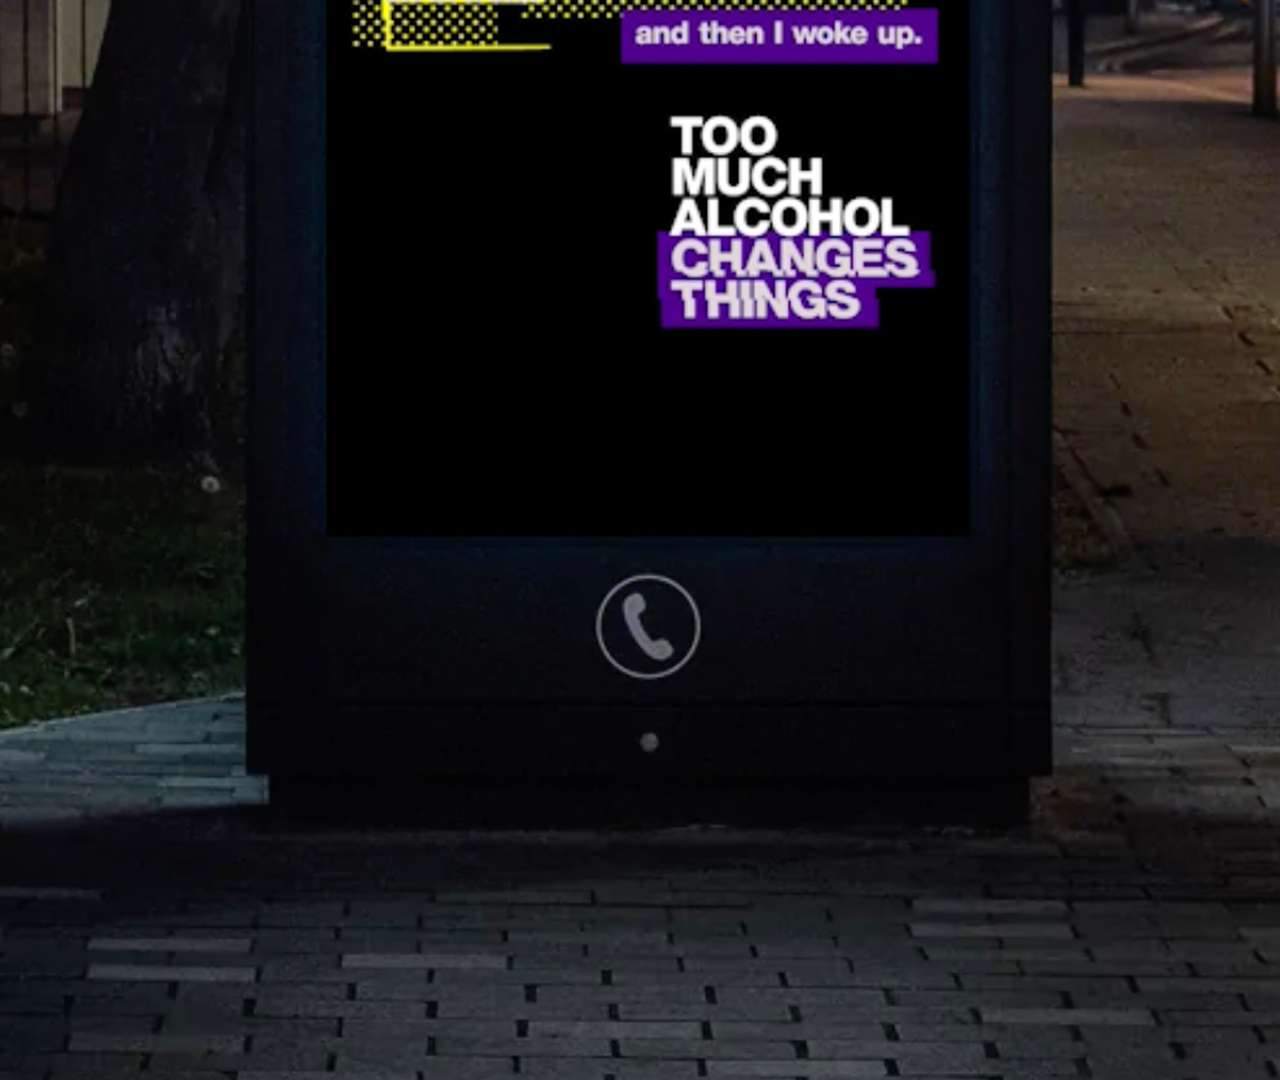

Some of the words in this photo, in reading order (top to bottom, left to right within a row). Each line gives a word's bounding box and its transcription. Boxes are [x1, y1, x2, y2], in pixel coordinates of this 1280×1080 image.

[635, 20, 689, 45] and
[699, 20, 765, 45] then
[774, 20, 783, 45] I
[791, 20, 869, 45] woke
[877, 25, 923, 50] up.
[670, 116, 778, 156] TOO
[672, 156, 823, 197] MUCH
[670, 197, 910, 237] ALCOHOL
[671, 238, 920, 278] CHANGES
[671, 279, 862, 319] THINGS
